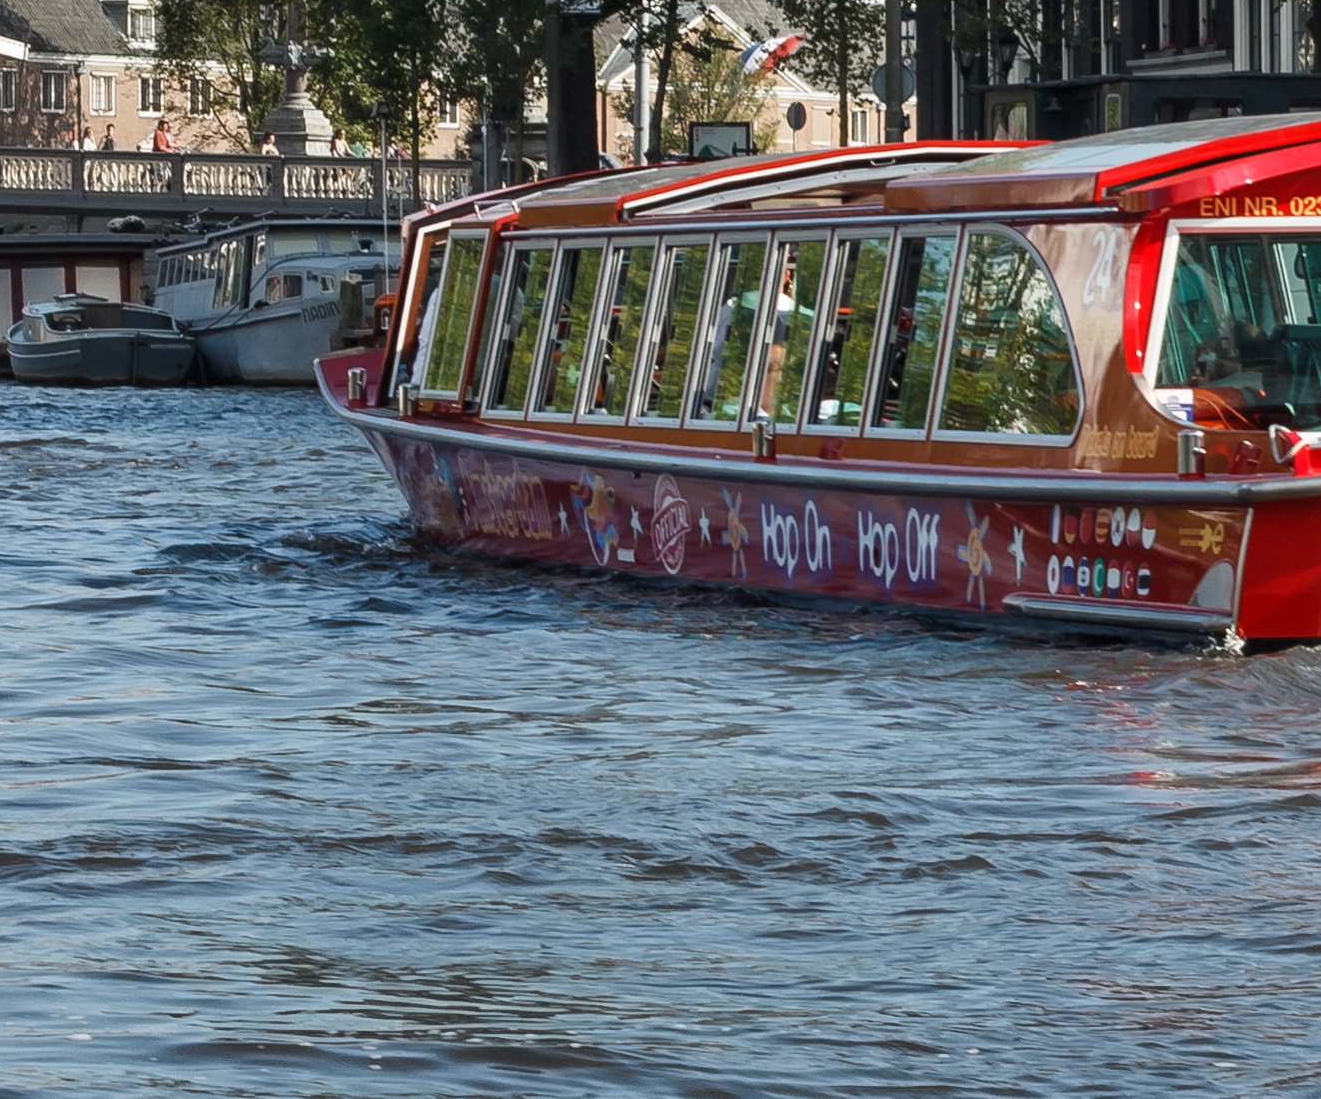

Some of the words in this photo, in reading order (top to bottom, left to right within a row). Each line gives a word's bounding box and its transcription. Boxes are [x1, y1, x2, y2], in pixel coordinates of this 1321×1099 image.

[1200, 197, 1237, 216] ENI
[1245, 197, 1284, 216] NR.
[301, 299, 341, 324] NADIN
[761, 502, 800, 579] Hop
[804, 499, 832, 573] On
[858, 510, 900, 590] Hop
[906, 507, 941, 583] Off
